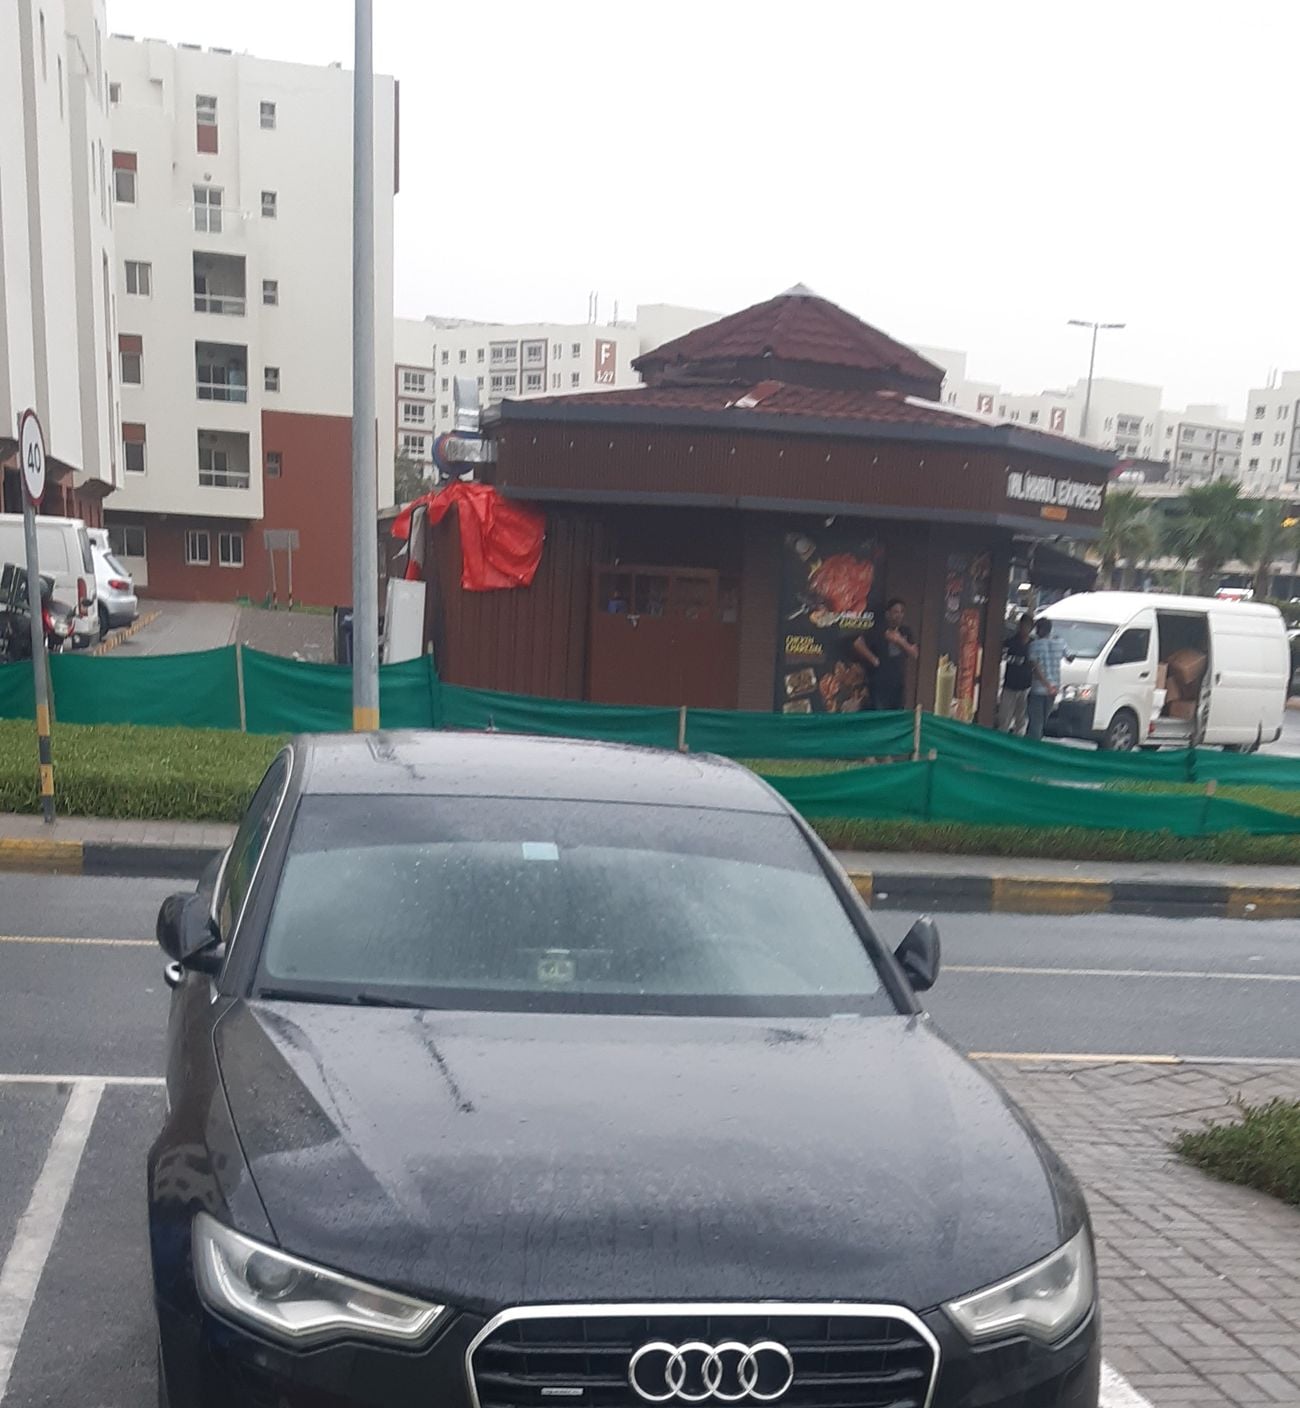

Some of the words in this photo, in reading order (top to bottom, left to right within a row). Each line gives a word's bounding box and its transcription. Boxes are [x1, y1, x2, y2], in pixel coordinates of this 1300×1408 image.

[601, 343, 611, 365] F
[1053, 409, 1062, 430] F
[27, 442, 41, 473] 40
[1056, 479, 1102, 511] EXPRESS
